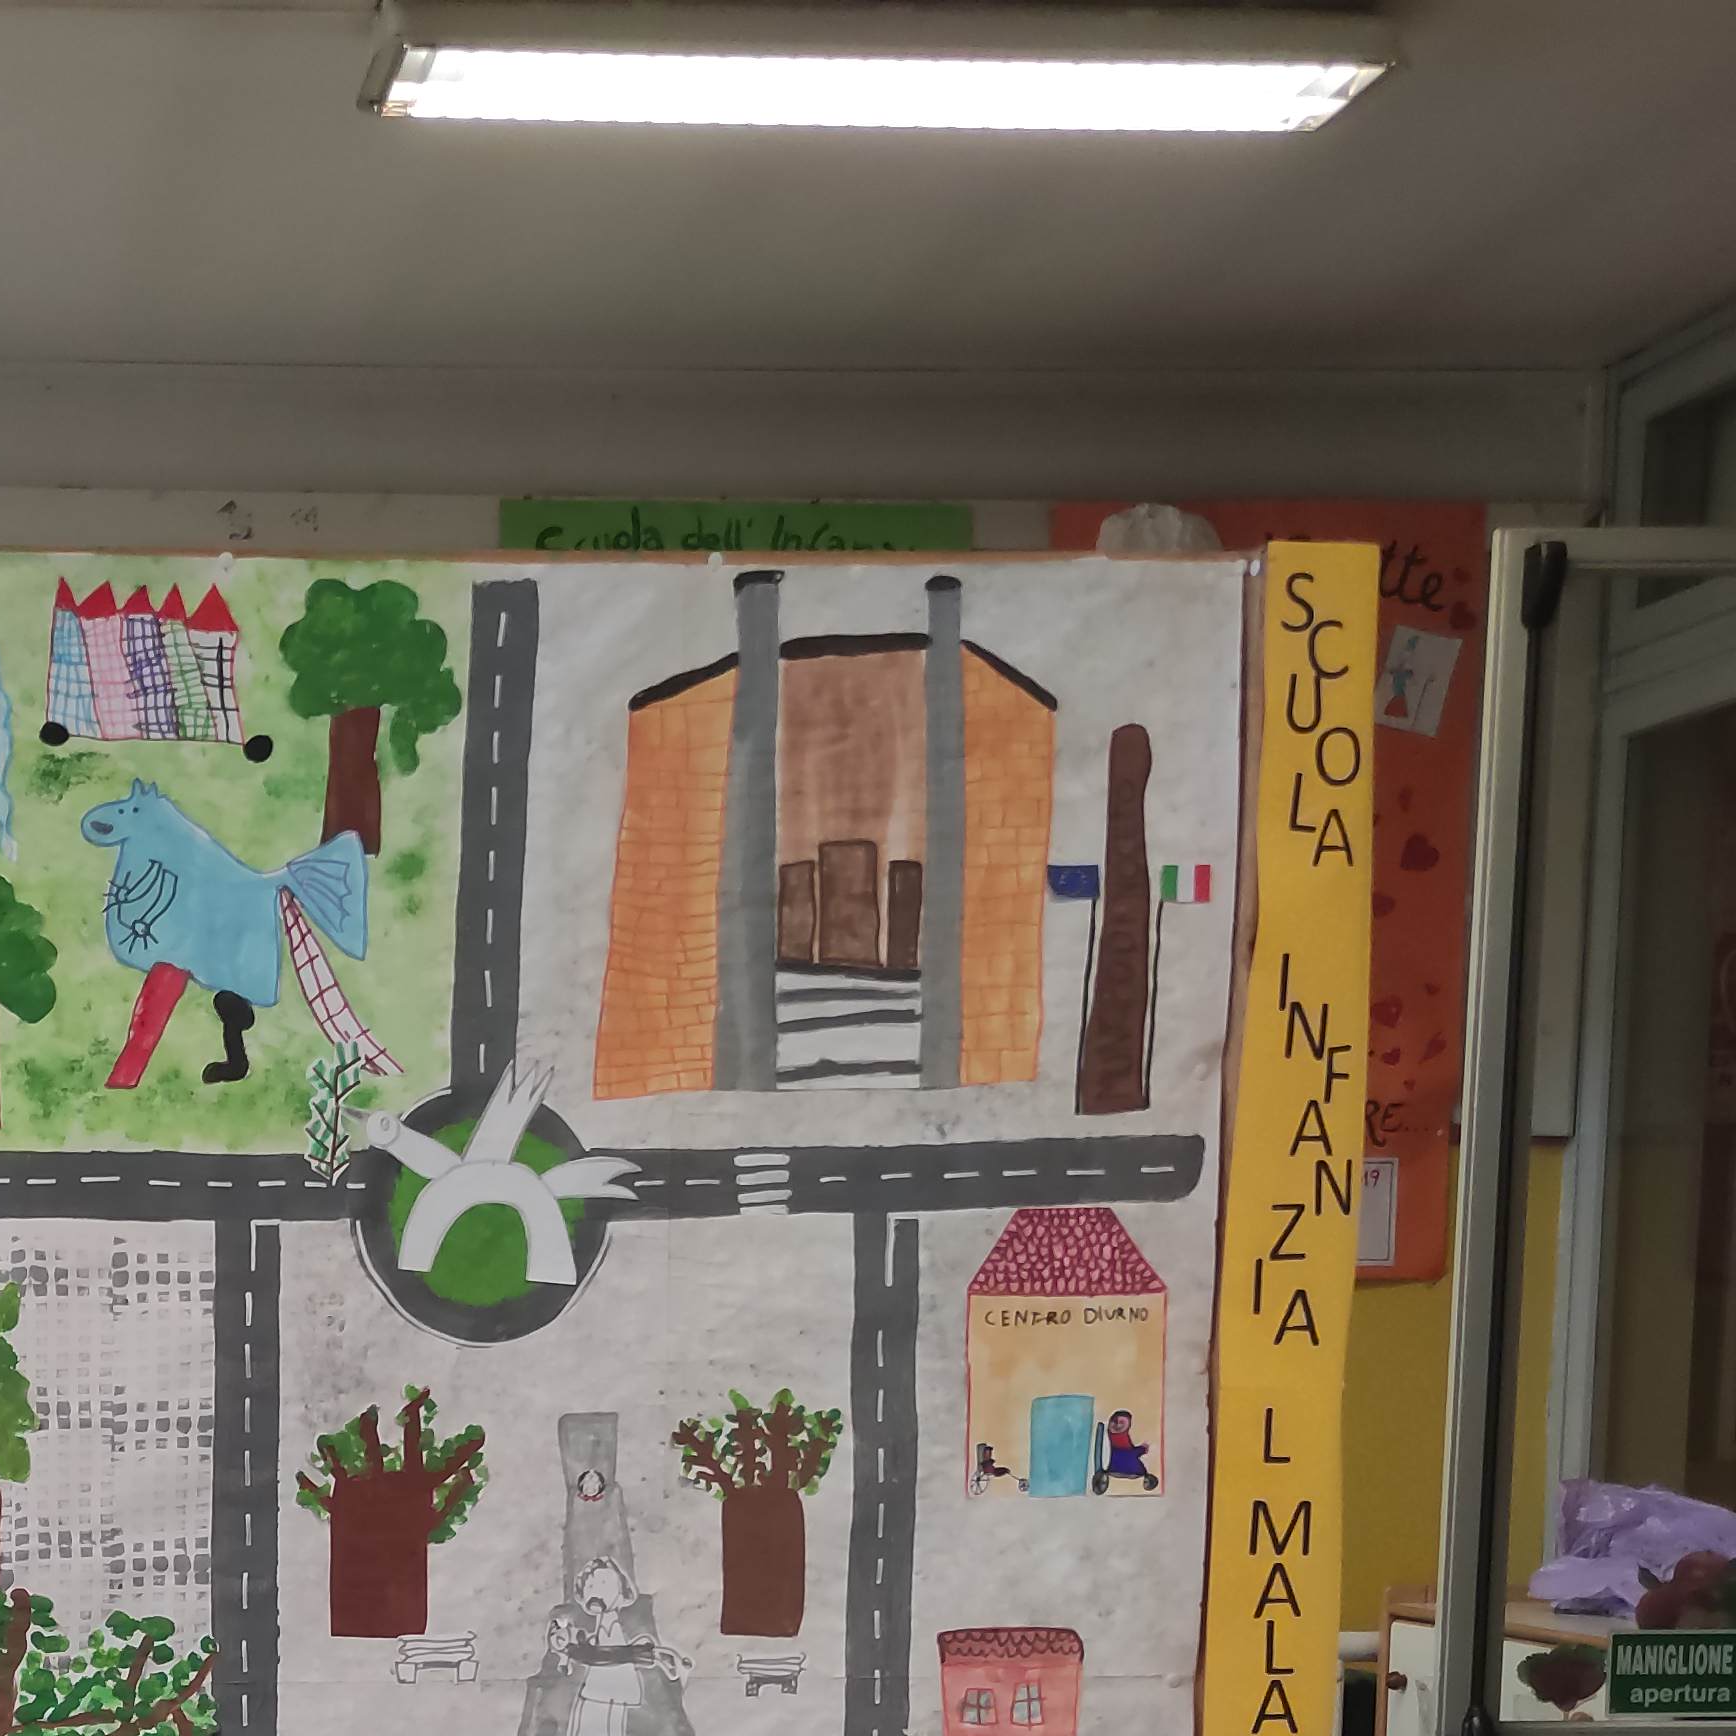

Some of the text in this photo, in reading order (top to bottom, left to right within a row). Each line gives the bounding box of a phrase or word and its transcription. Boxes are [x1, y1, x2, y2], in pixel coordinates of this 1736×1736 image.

[1281, 572, 1361, 867] SCUOLA
[1253, 952, 1353, 1347] INFANZIA
[984, 1306, 1149, 1327] CENTRO DIURNO
[1263, 1407, 1291, 1464] L
[1616, 1644, 1734, 1676] MANIGLIONE
[1630, 1684, 1731, 1707] apertura
